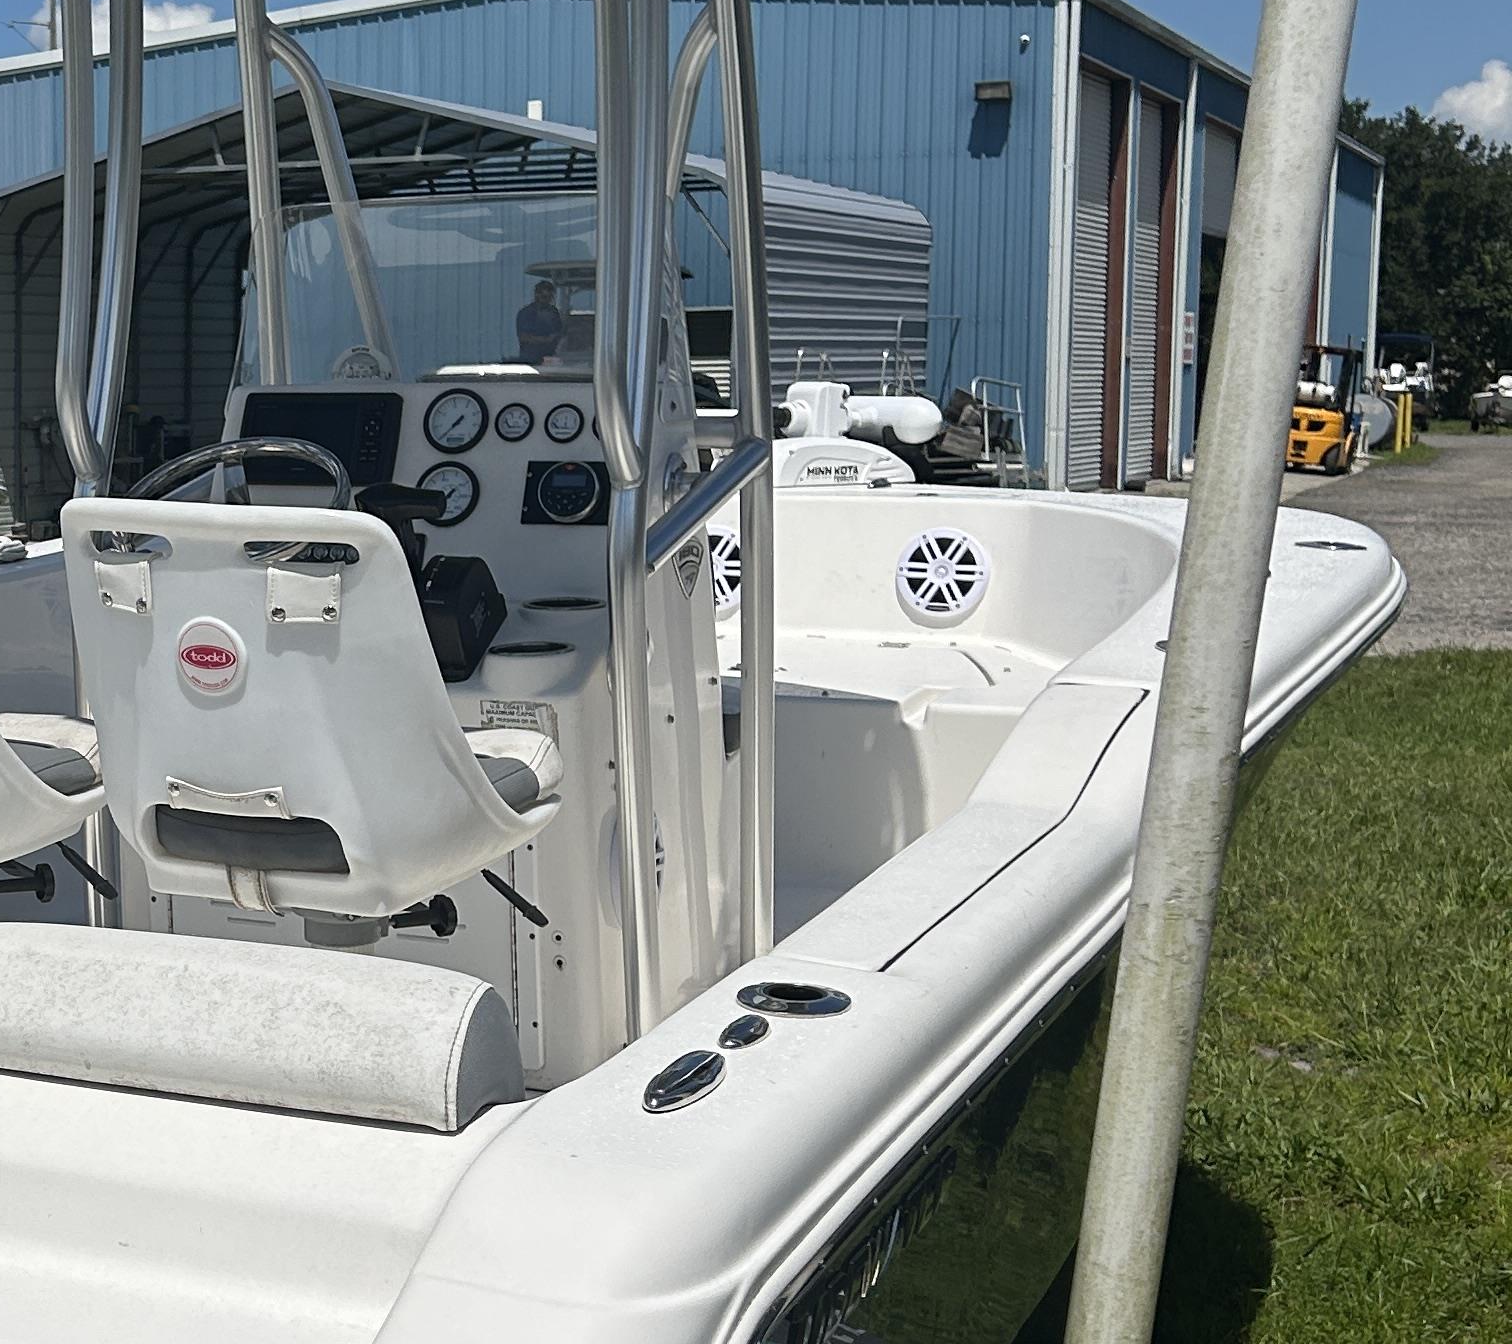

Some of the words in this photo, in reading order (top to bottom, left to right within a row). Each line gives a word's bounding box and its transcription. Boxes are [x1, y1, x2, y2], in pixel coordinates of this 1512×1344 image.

[807, 466, 832, 476] MINN
[834, 465, 859, 475] KOTA
[190, 650, 226, 663] todd
